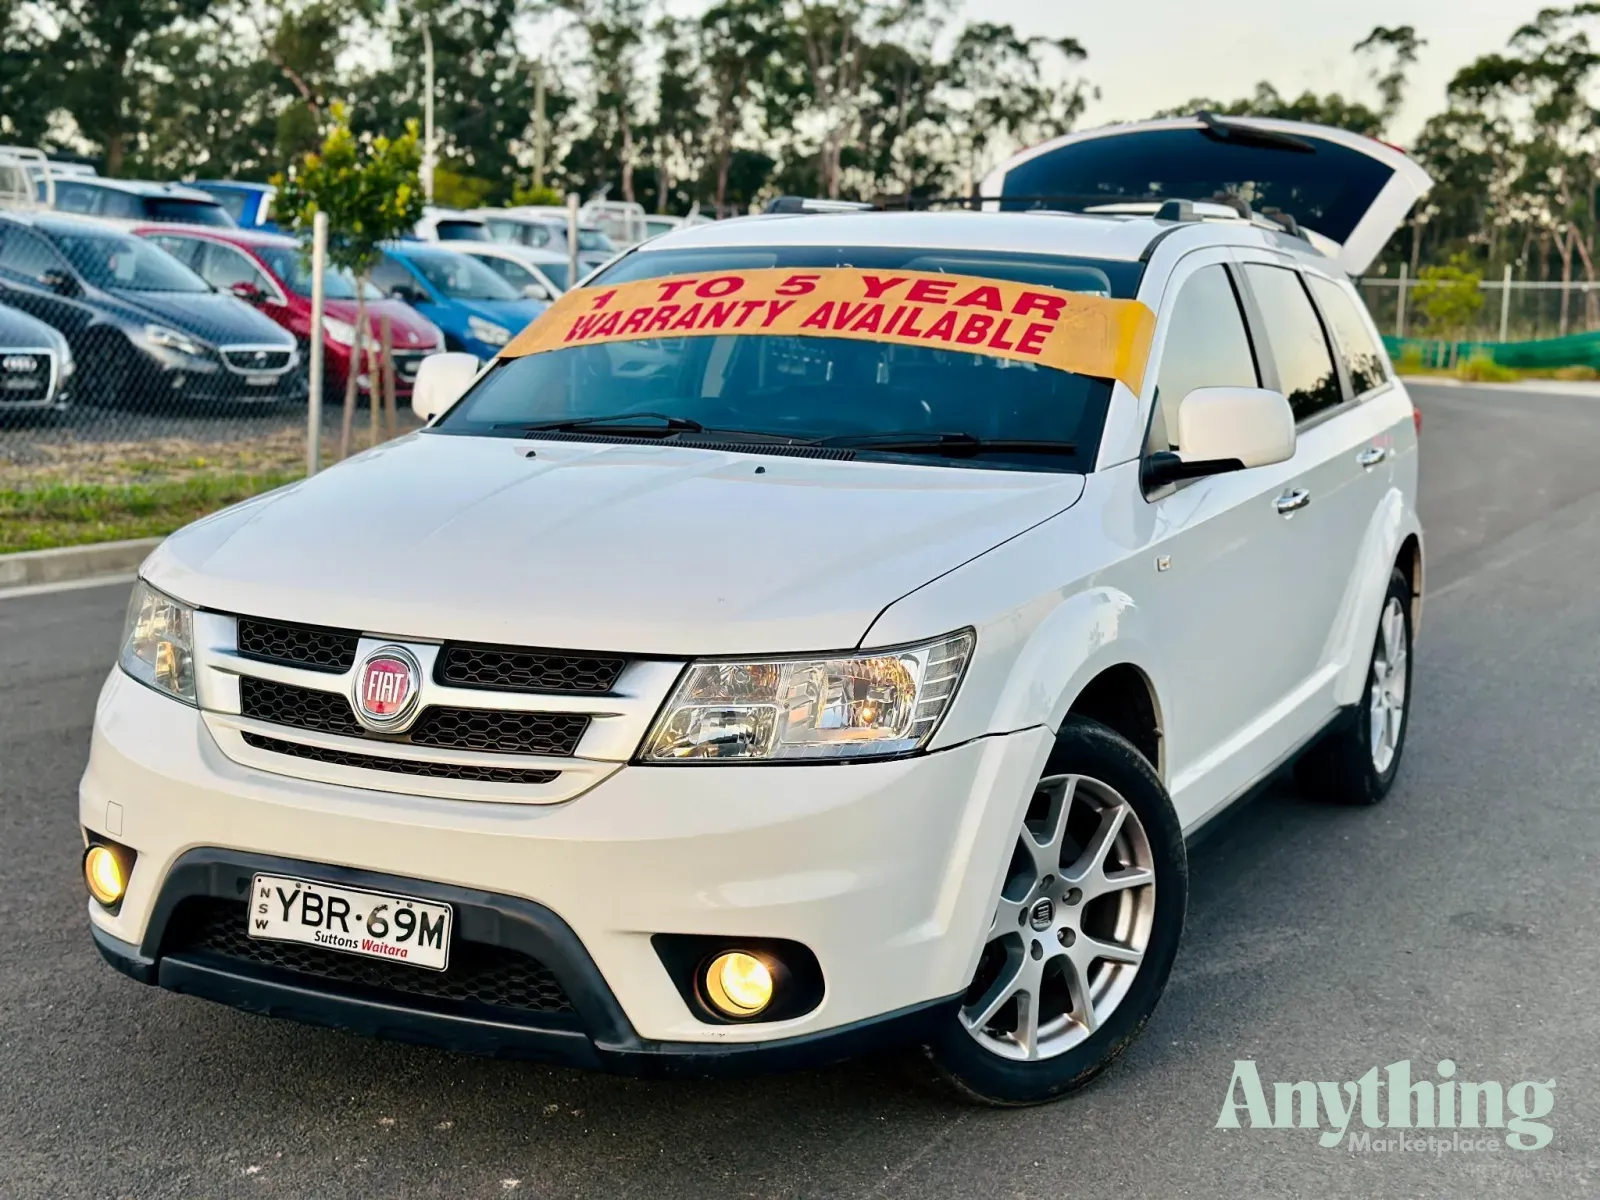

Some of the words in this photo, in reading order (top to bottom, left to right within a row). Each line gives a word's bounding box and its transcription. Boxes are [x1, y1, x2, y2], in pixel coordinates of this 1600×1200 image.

[591, 290, 618, 310] 1
[657, 276, 745, 302] TO
[775, 275, 821, 296] 5
[862, 275, 1067, 321] YEAR
[563, 300, 797, 342] WARRANTY
[801, 301, 1054, 355] AVAILABLE
[367, 671, 405, 704] FIAT
[314, 930, 359, 949] Suttons
[361, 938, 408, 958] Waitara
